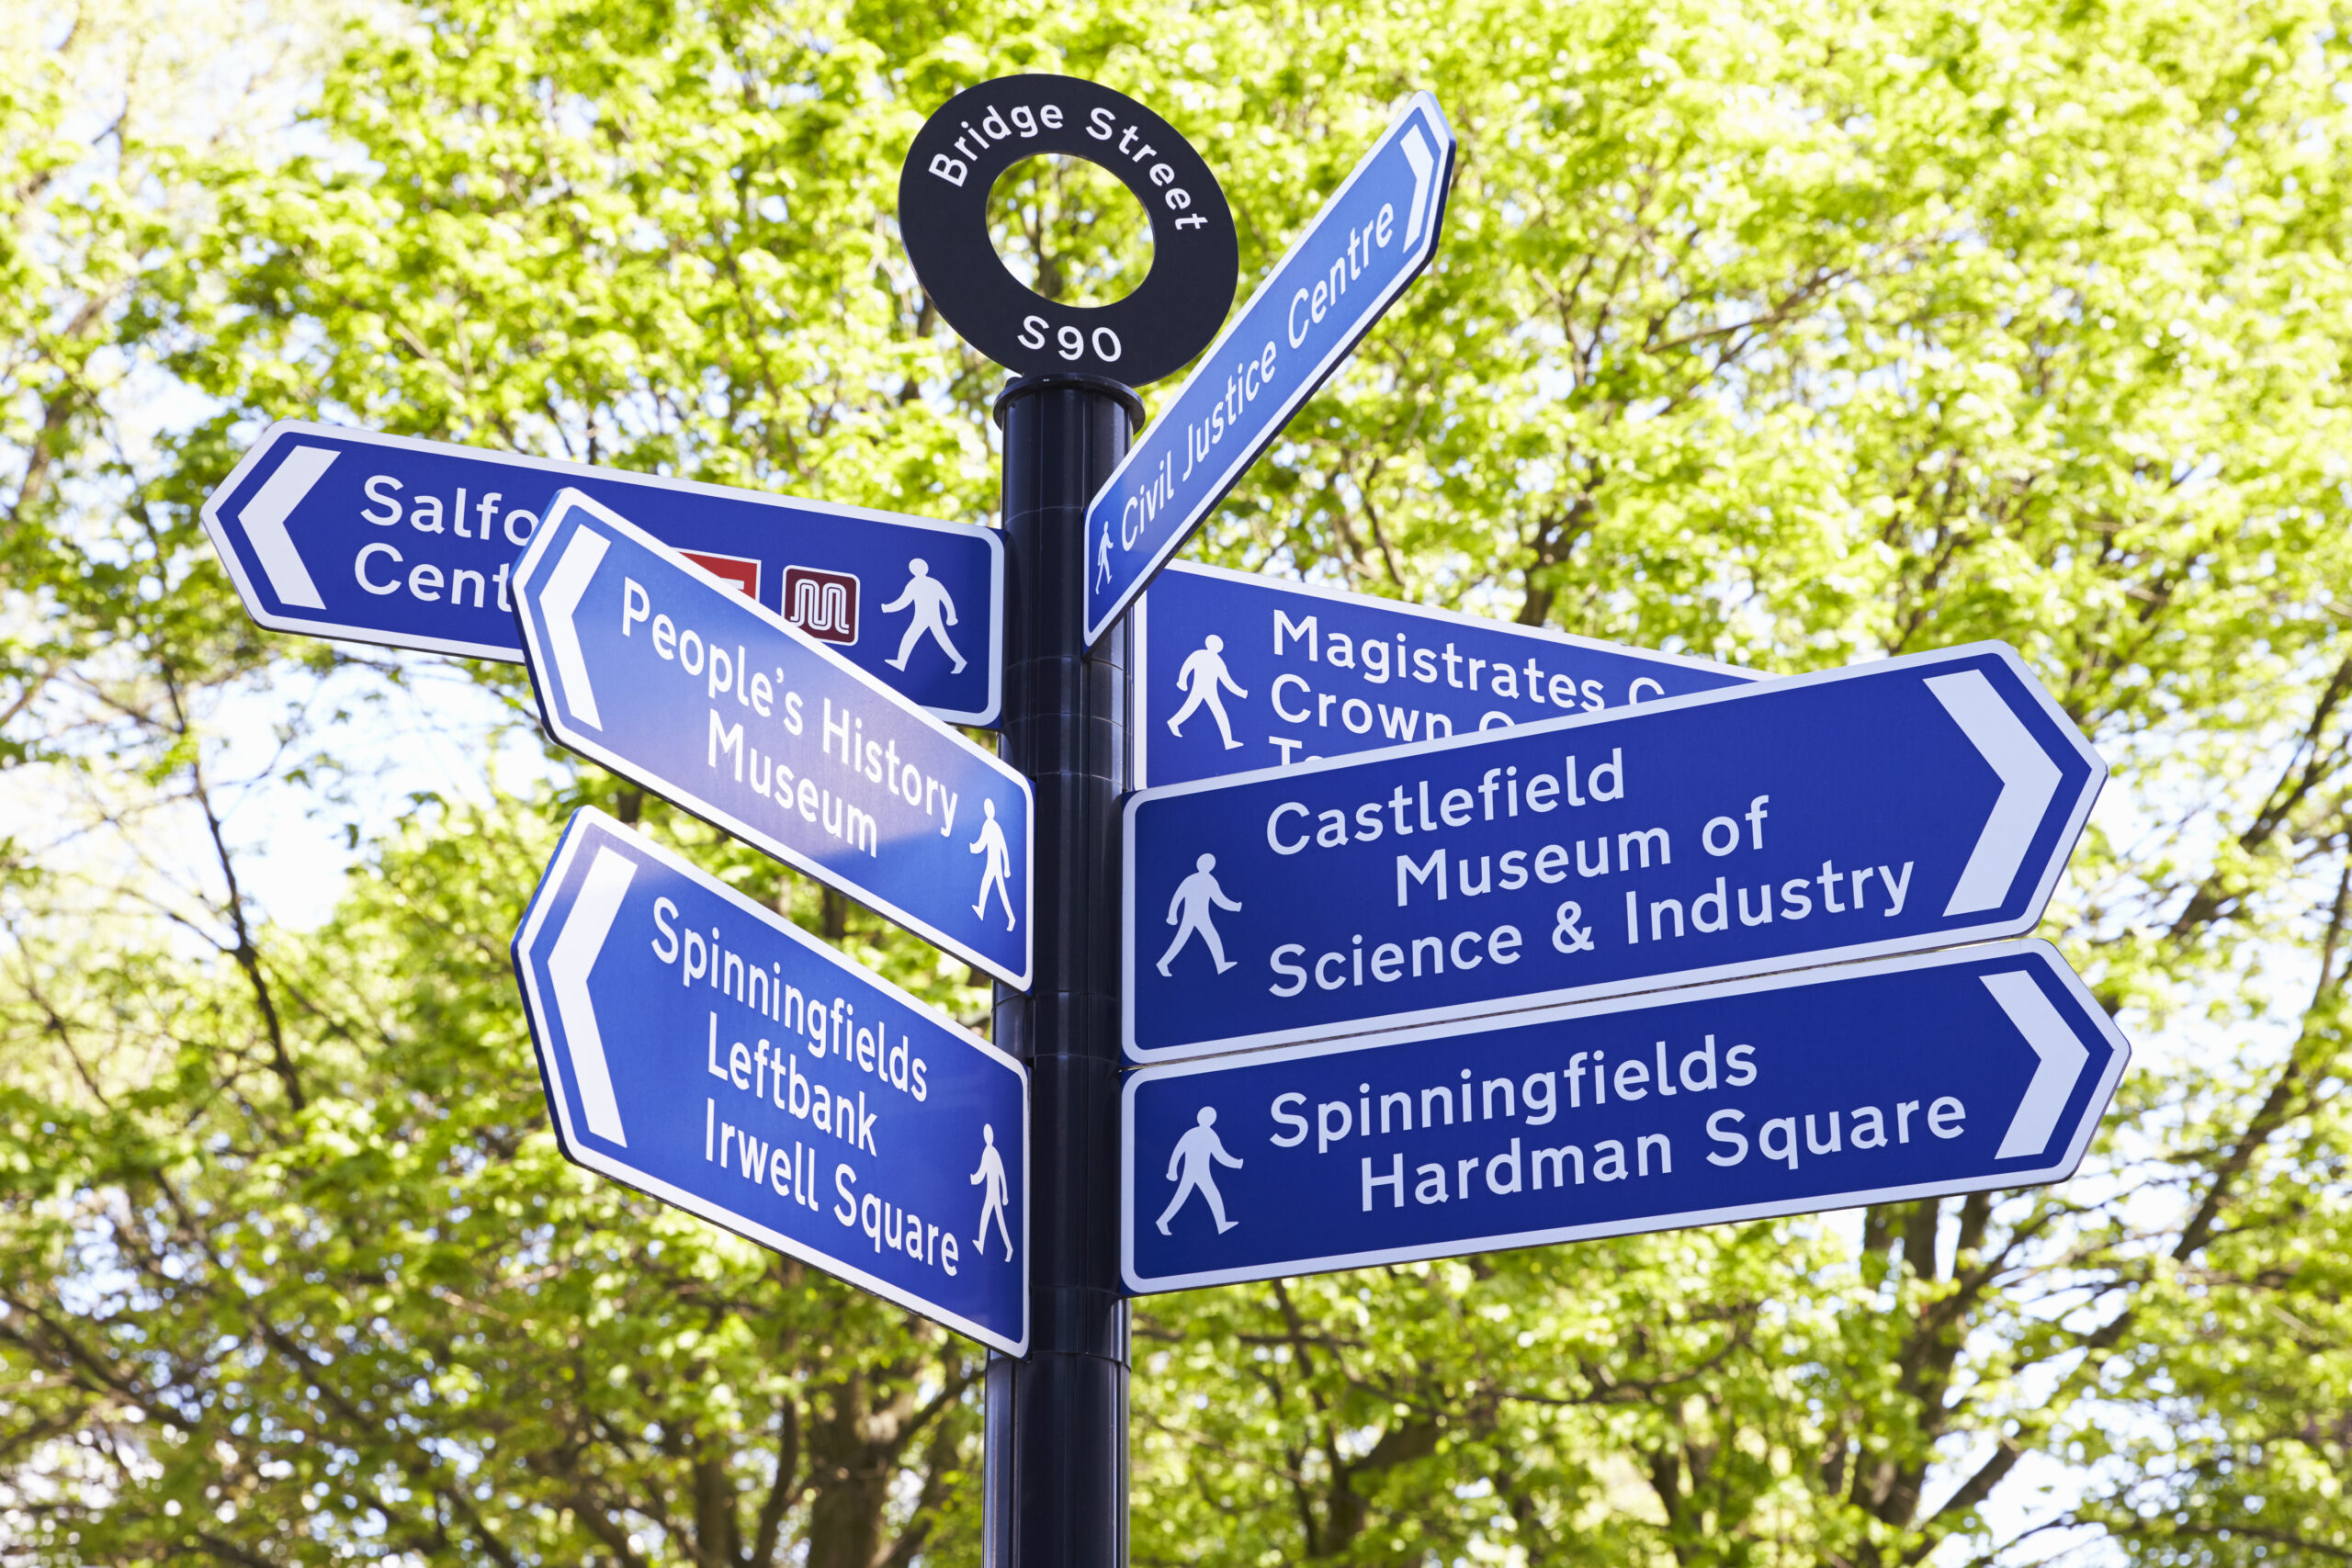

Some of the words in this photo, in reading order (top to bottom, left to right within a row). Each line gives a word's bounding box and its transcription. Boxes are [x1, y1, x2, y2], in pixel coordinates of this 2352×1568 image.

[929, 104, 1063, 186] Bridge
[1086, 108, 1207, 230] Street
[1018, 316, 1121, 361] S90
[1122, 450, 1174, 551] Civil
[1182, 341, 1276, 481] Justice
[1288, 203, 1394, 349] Centre
[622, 577, 803, 737] People's
[822, 698, 957, 838] History
[1272, 674, 1452, 741] Crown
[1274, 610, 1604, 711] Magistrates
[709, 708, 876, 856] Museum
[1268, 748, 1623, 854] Castlefield
[1397, 829, 1670, 906] Museum
[1702, 795, 1769, 856] of
[1270, 926, 1521, 997] Science
[1553, 901, 1594, 953] &
[1627, 862, 1914, 943] Industry
[651, 897, 926, 1101] Spinningfields
[708, 1011, 877, 1156] Leftbank
[1271, 1034, 1757, 1154] Spinningfields
[706, 1098, 818, 1212] Irwell
[834, 1164, 958, 1276] Square
[1363, 1134, 1671, 1211] Hardman
[1707, 1097, 1965, 1169] Square
